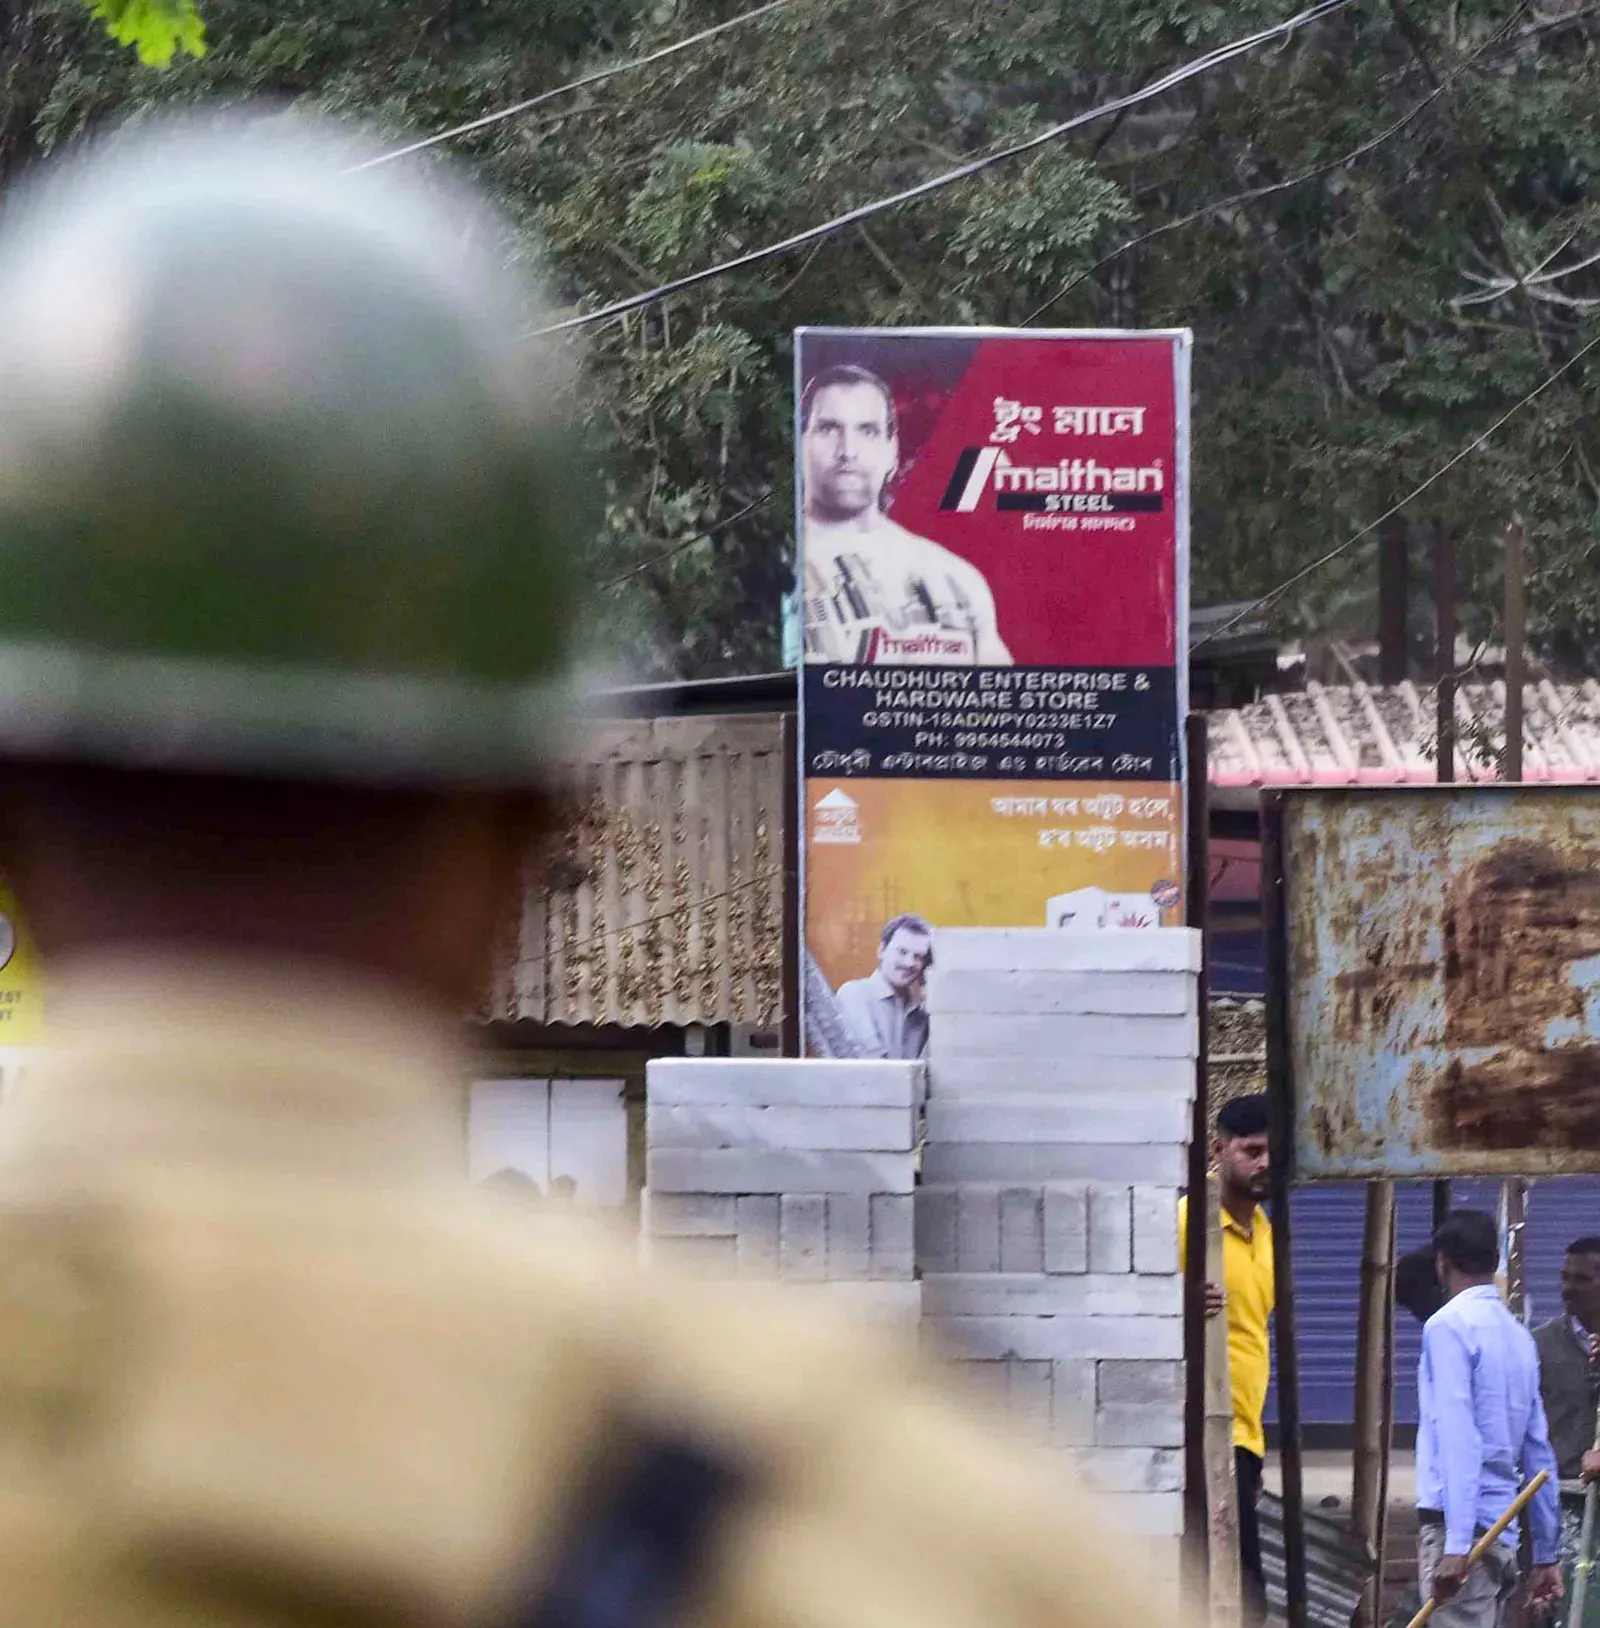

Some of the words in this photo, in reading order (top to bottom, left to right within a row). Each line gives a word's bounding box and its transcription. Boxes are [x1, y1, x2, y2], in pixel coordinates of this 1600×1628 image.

[993, 457, 1164, 491] maithan
[1045, 494, 1115, 512] STEEL
[822, 670, 973, 689] CHAUDHURY
[979, 672, 1127, 691] ENTERPRISE
[1134, 673, 1151, 691] &
[875, 690, 1014, 709] HARDWARE
[1019, 691, 1100, 710] STORE
[915, 732, 949, 748] PH:
